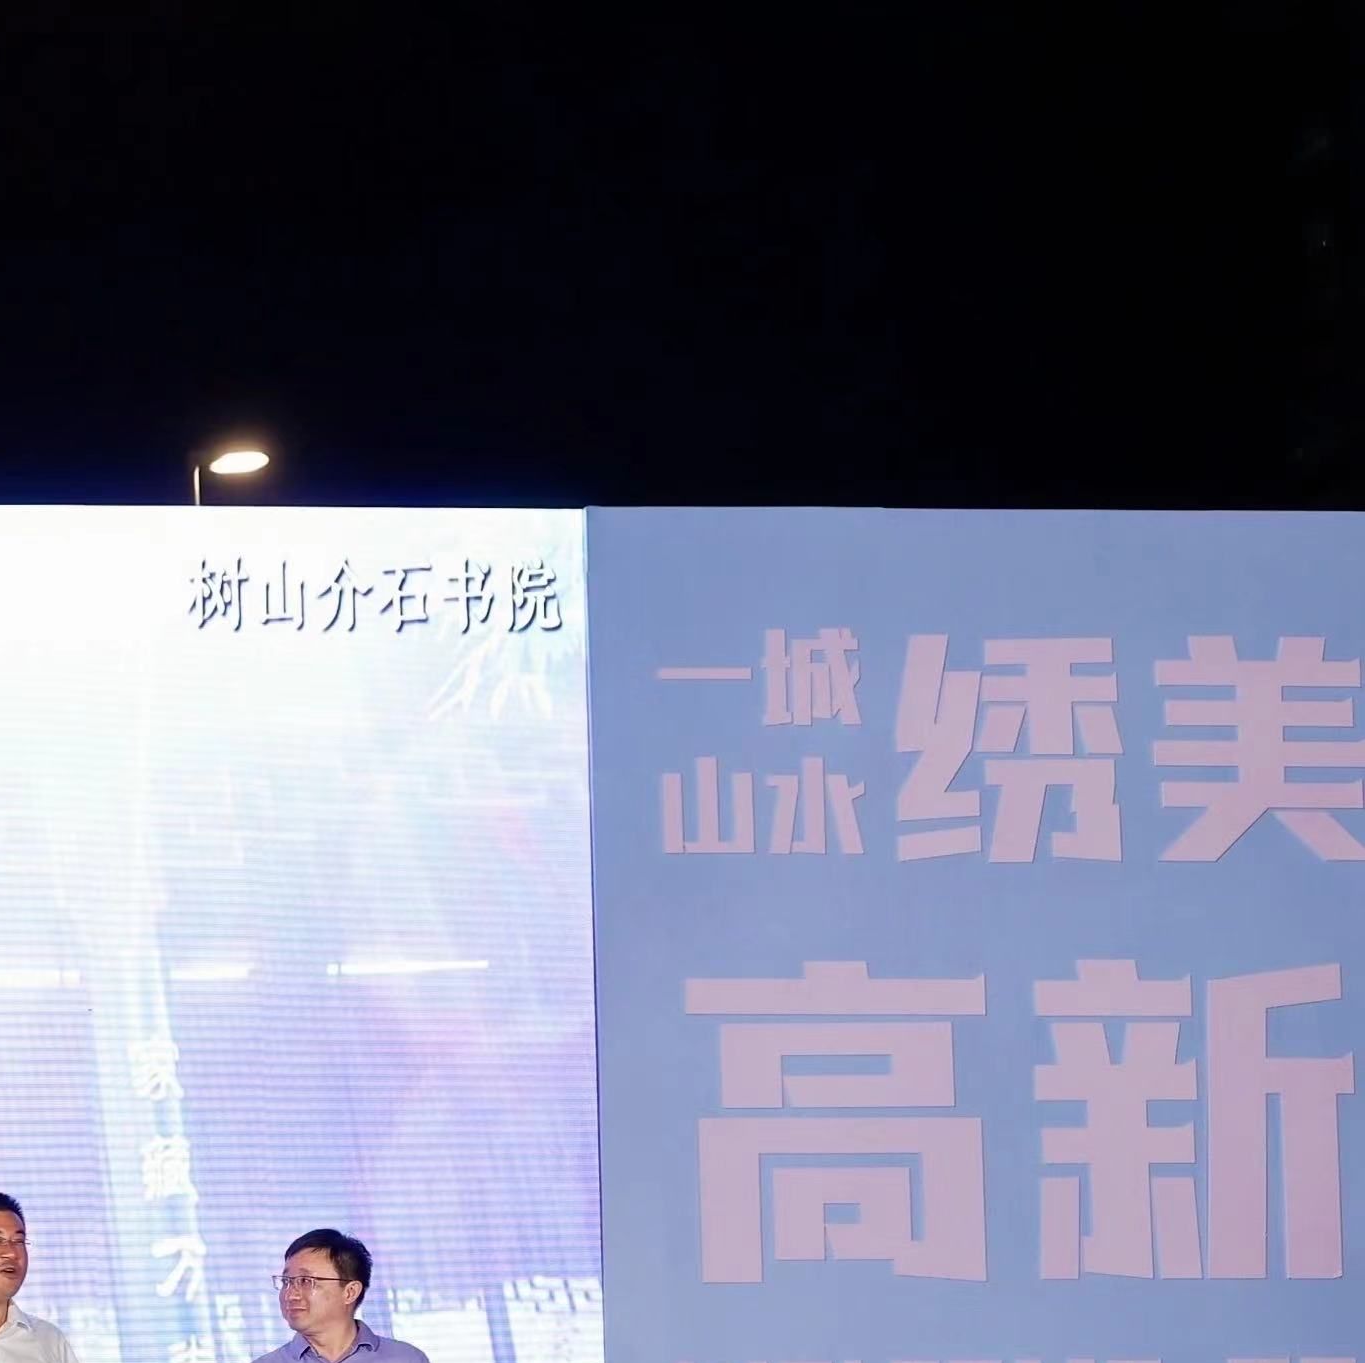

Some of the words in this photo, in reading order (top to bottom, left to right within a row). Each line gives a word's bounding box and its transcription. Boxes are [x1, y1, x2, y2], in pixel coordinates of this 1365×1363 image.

[186, 555, 564, 635] 树山介石书院
[657, 627, 862, 726] 一城
[895, 633, 1365, 864] 绣美
[663, 756, 866, 855] 山水
[684, 958, 1356, 1284] 高新
